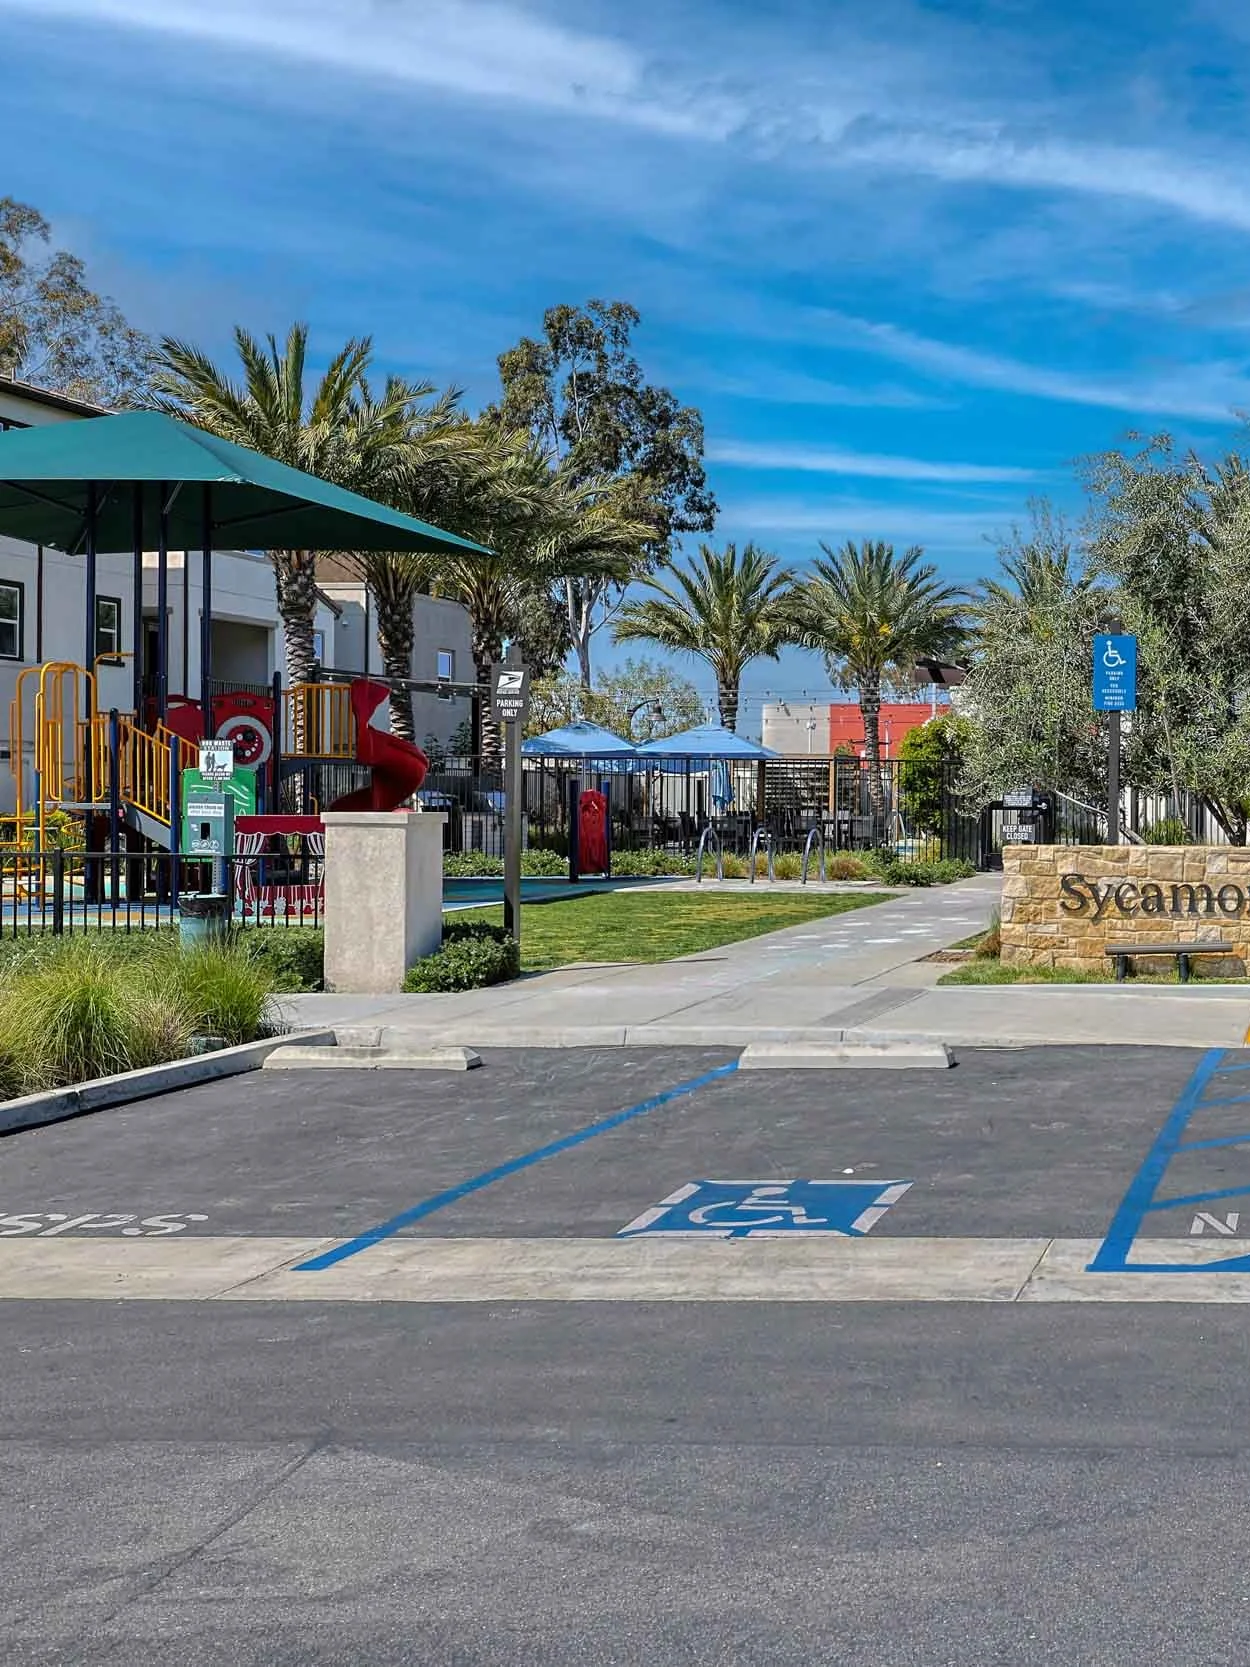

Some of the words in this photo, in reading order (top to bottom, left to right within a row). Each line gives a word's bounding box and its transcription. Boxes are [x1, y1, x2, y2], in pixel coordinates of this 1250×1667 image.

[496, 699, 524, 708] PARKING
[502, 708, 518, 717] ONLY
[1002, 825, 1017, 833] KEEP
[1018, 825, 1033, 833] GATE
[1006, 832, 1029, 840] CLOSED
[0, 1212, 209, 1236] SPS
